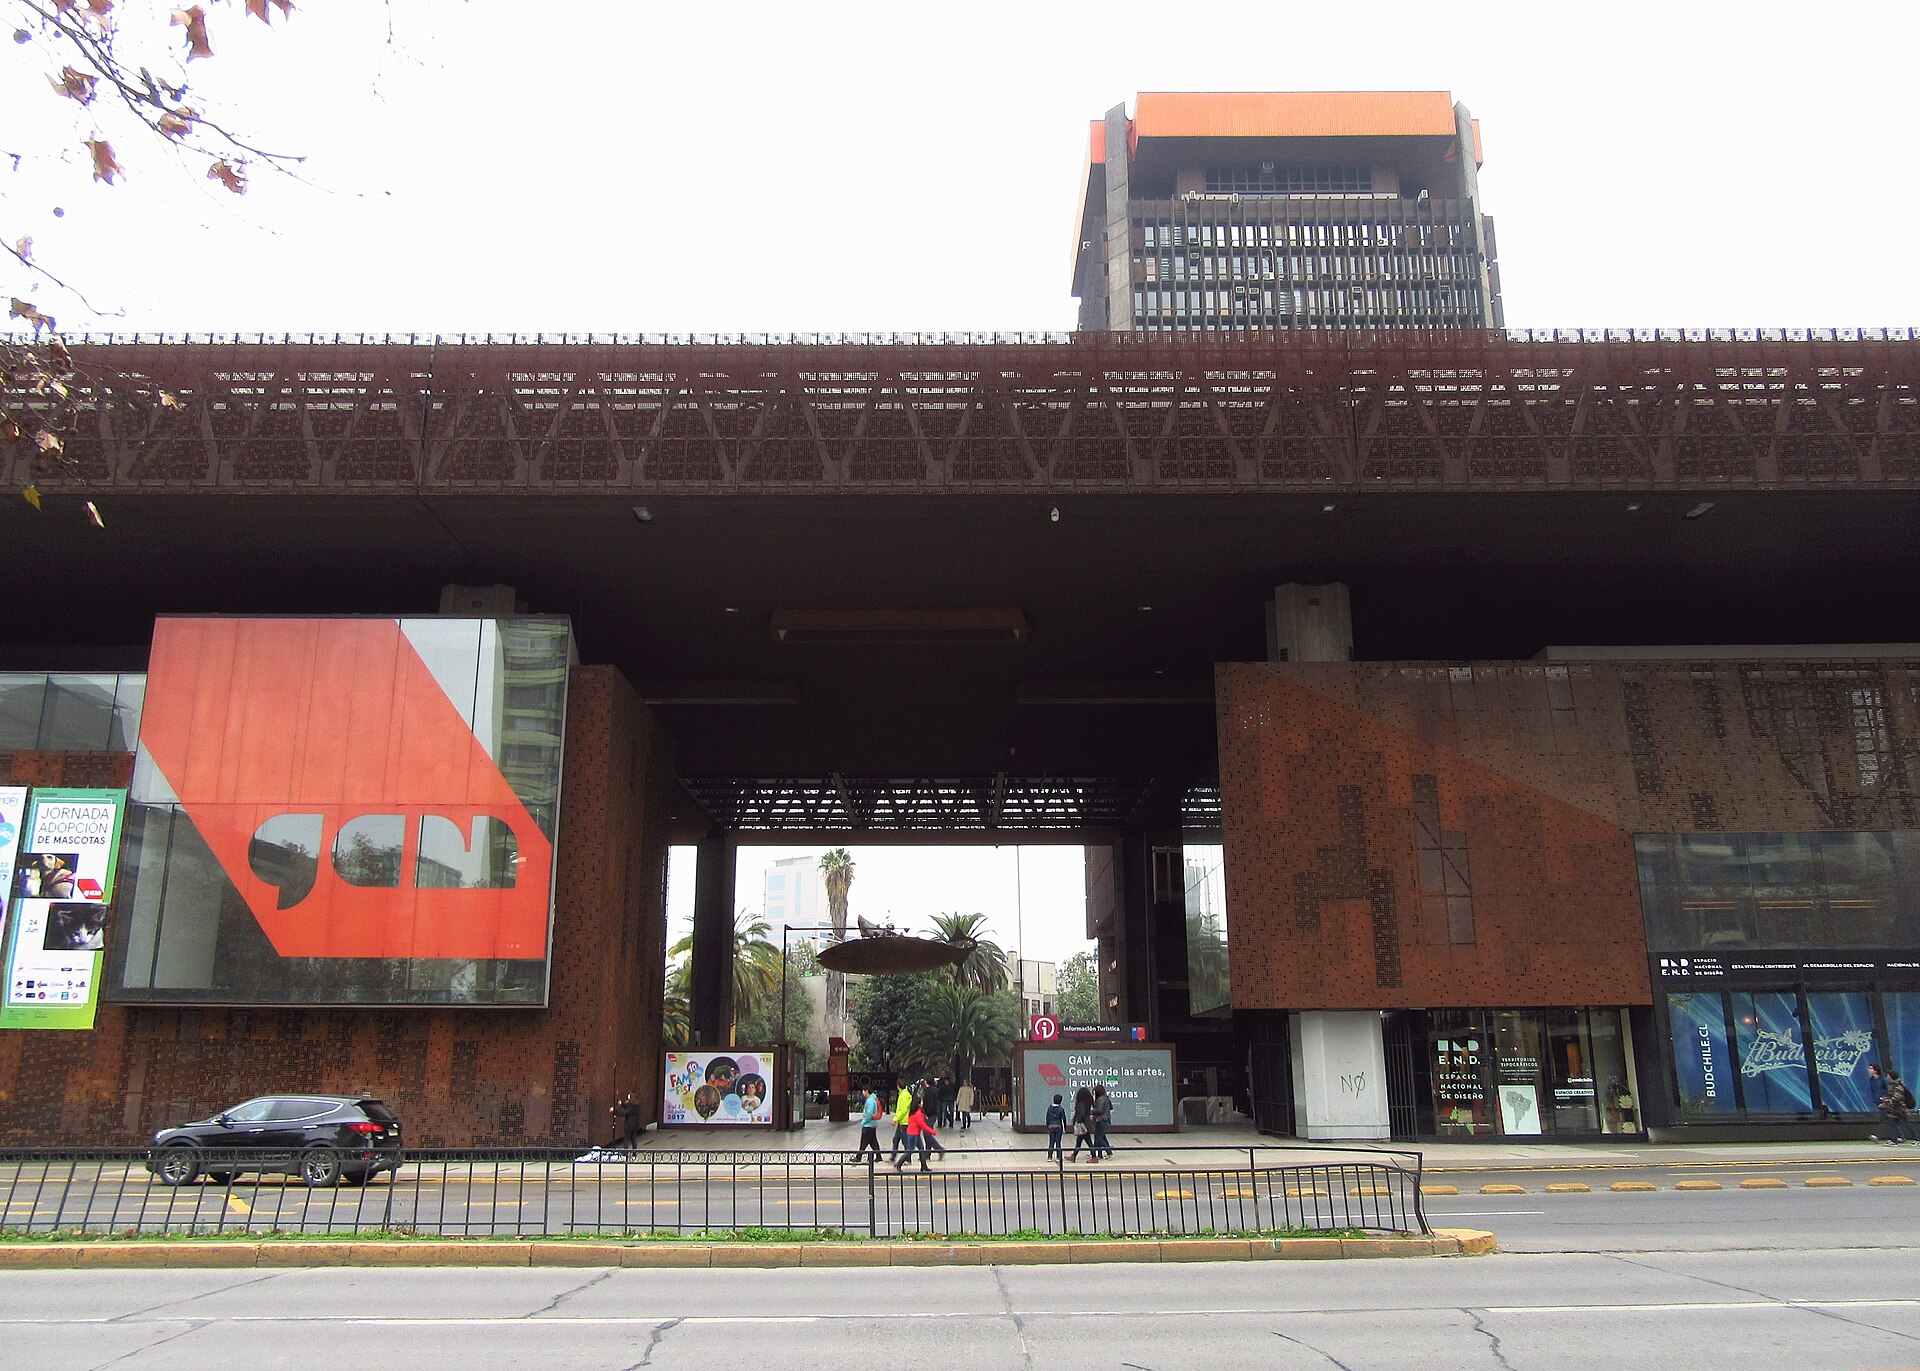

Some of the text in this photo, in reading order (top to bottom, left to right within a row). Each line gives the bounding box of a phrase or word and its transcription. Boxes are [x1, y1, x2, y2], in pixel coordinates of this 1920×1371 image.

[41, 807, 109, 820] JORNADA
[38, 820, 108, 834] ADOPCIÓN
[37, 835, 106, 845] DE MASCOTAS
[1748, 1041, 1860, 1062] Budeiser
[1068, 1055, 1092, 1065] GAM
[1699, 1024, 1716, 1098] BUDCHILE.CL
[1068, 1067, 1166, 1077] Centro de las artes,
[670, 1073, 692, 1088] FAM
[1069, 1078, 1077, 1087] la
[1454, 1092, 1484, 1100] DISEÑO
